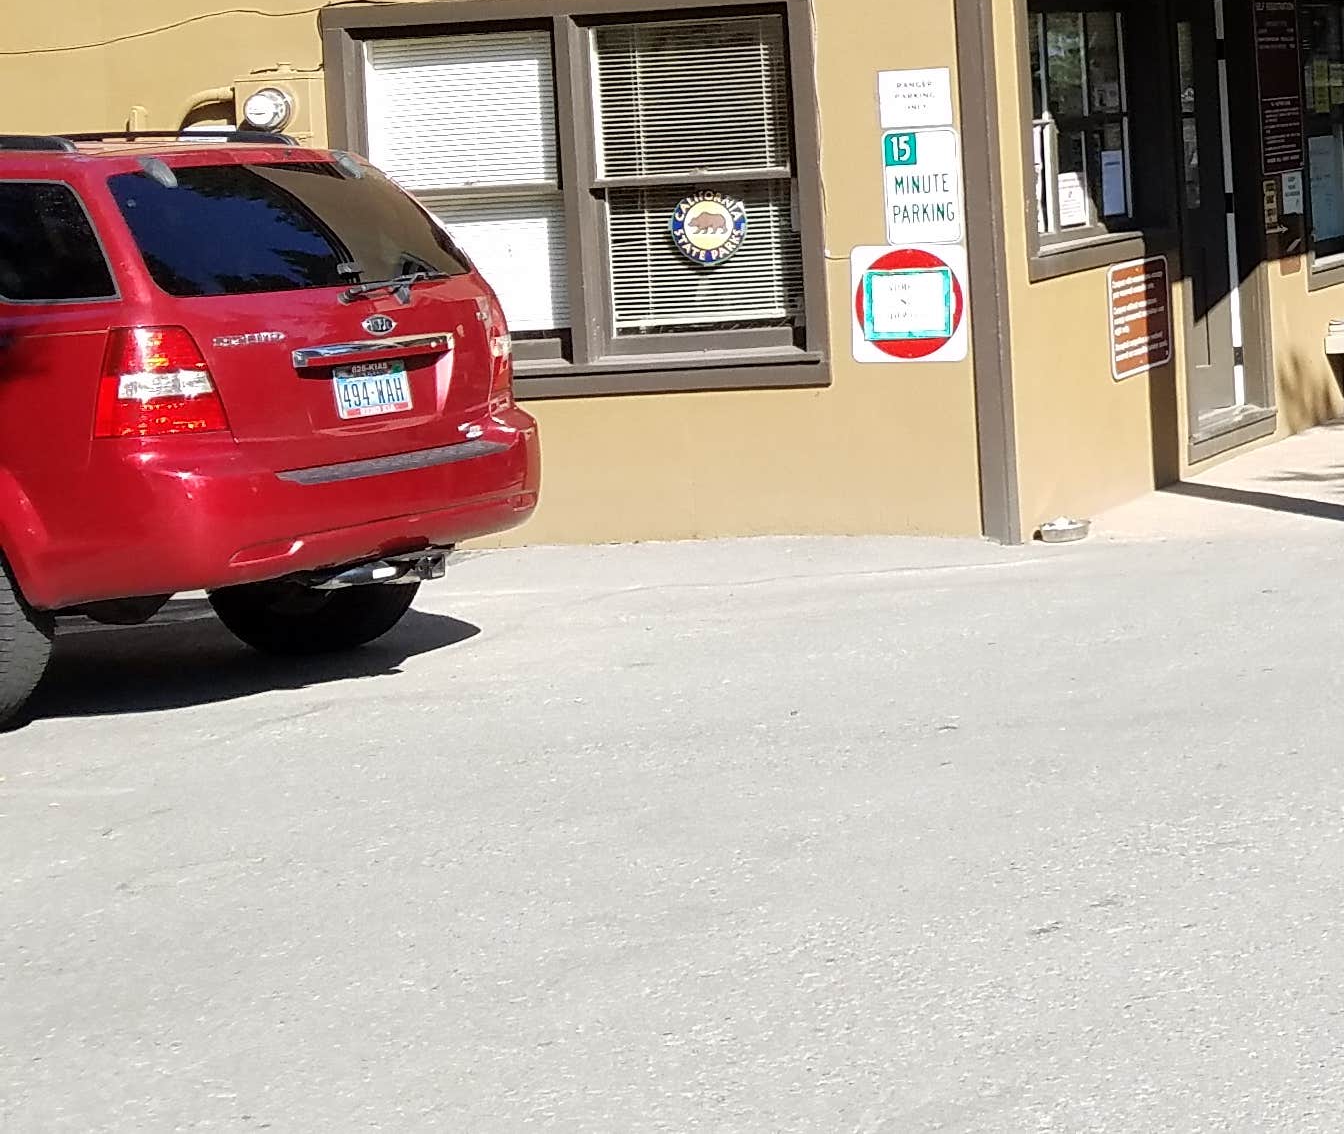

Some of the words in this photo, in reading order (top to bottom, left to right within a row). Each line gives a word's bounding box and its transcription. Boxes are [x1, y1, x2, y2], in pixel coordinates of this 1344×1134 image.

[890, 135, 911, 162] 15
[894, 173, 949, 195] MINUTE
[675, 191, 744, 221] CALIFORNIA
[892, 202, 955, 224] PARKING
[674, 228, 706, 261] STATE
[711, 228, 745, 261] PARKS
